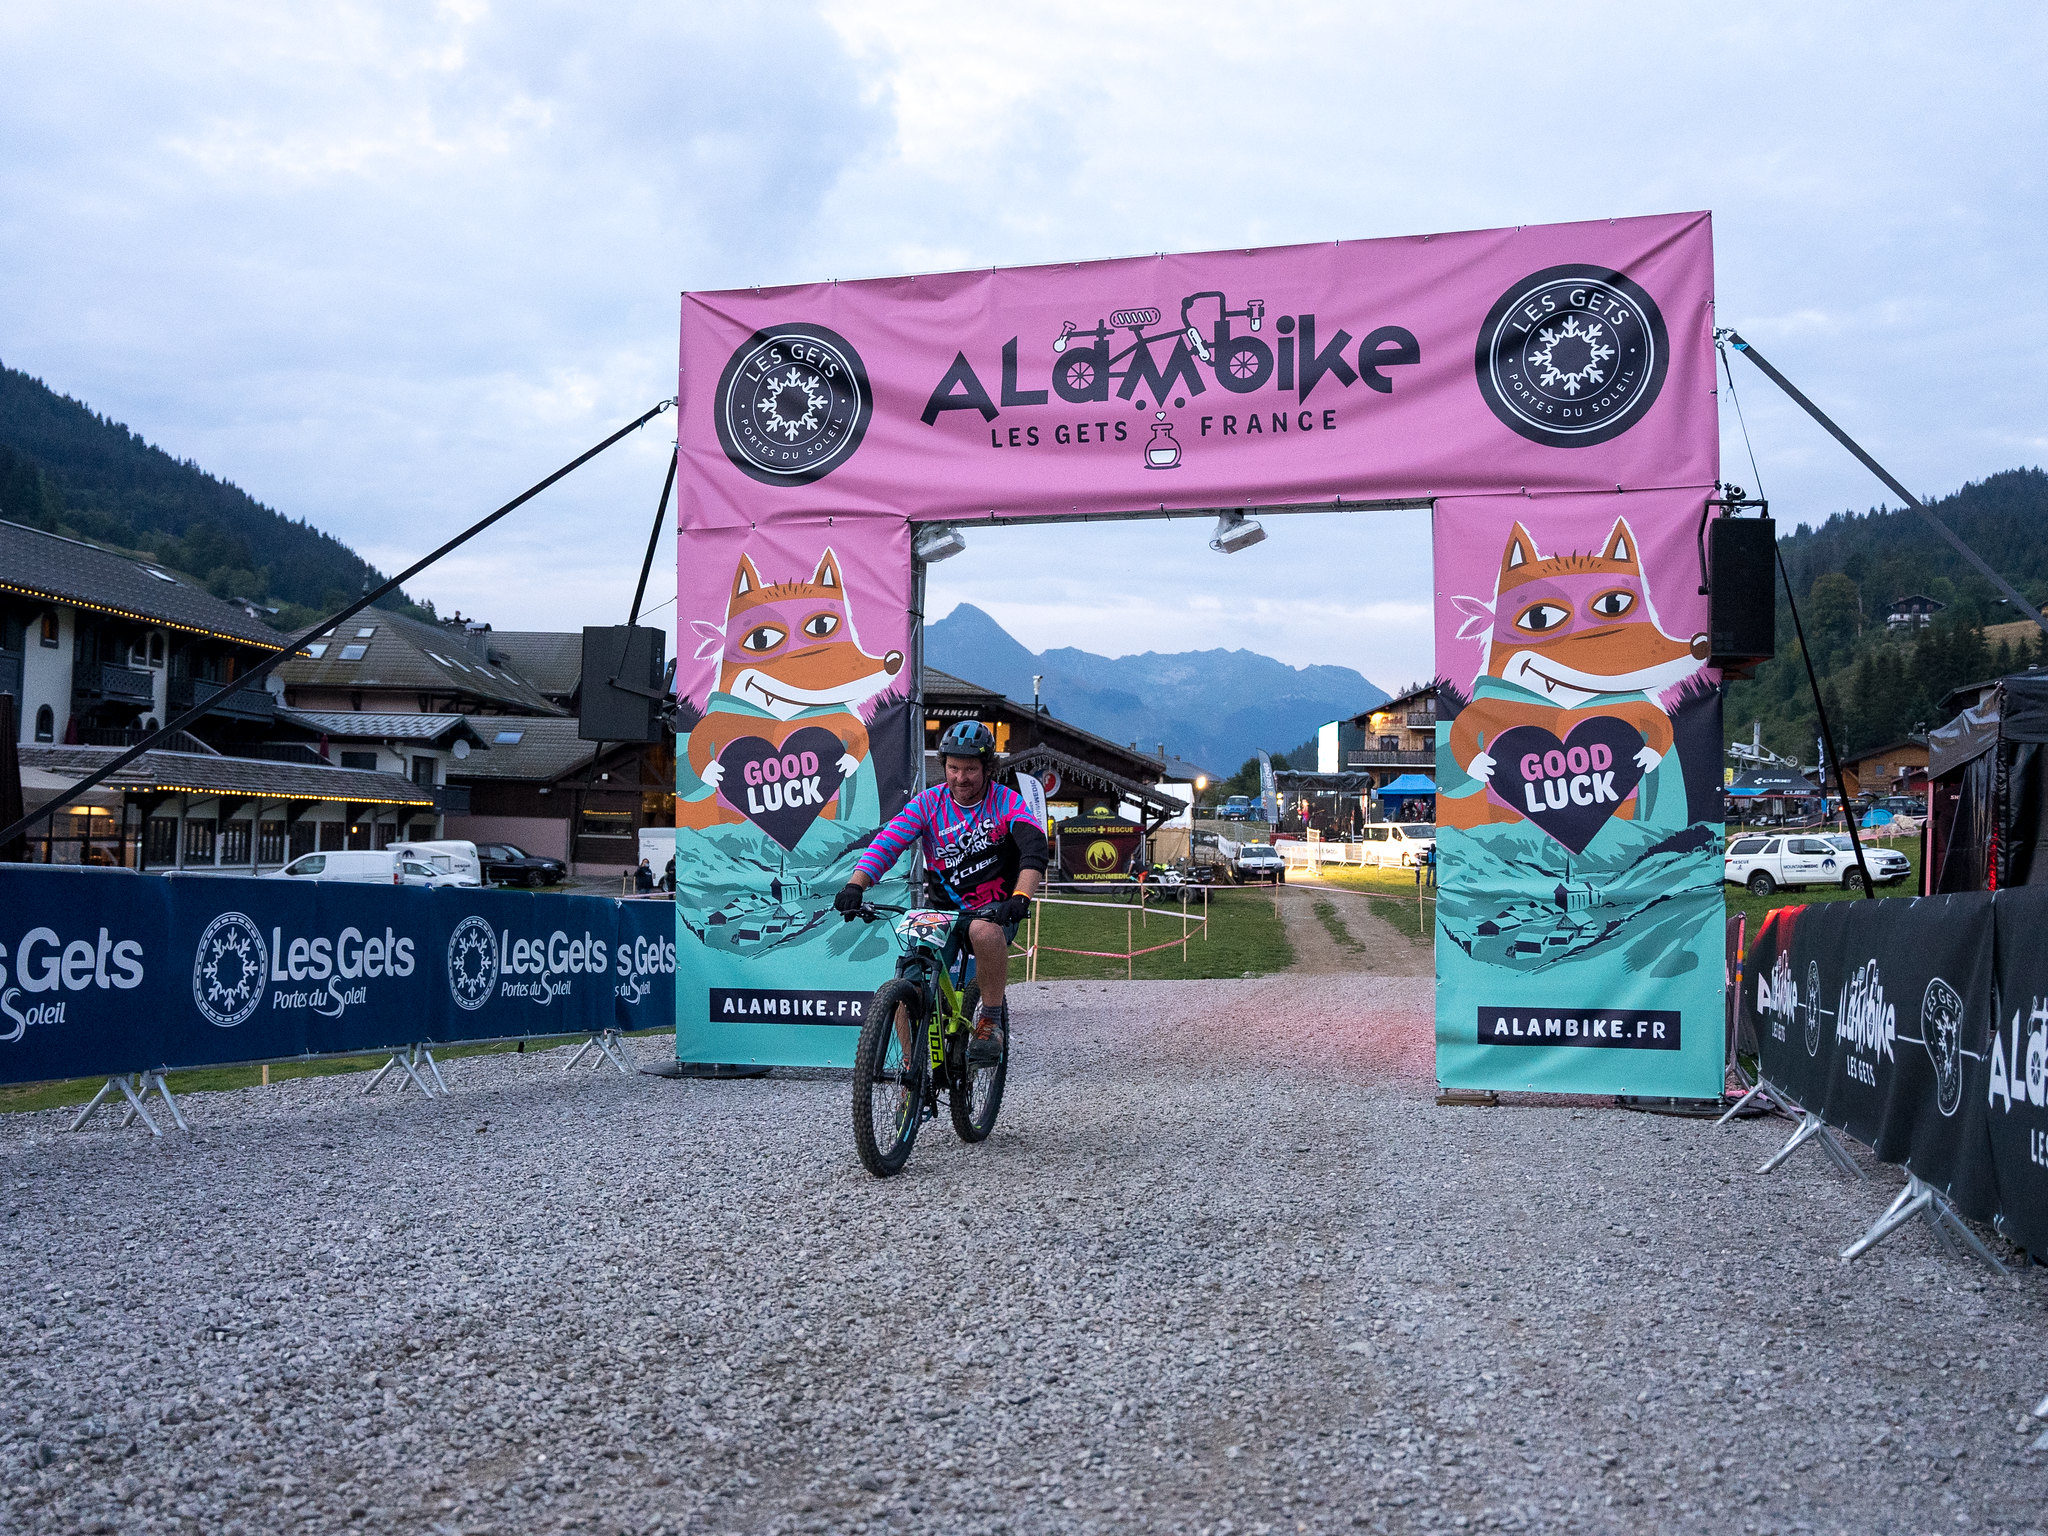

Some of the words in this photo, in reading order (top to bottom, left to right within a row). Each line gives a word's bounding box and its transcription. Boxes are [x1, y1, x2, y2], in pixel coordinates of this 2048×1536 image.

[1512, 295, 1556, 333] LES
[1569, 289, 1630, 325] GETS
[746, 348, 782, 382] LES
[791, 343, 839, 378] GETS
[1509, 373, 1554, 414] PORTES
[1563, 408, 1583, 417] DU
[1592, 370, 1634, 413] SOLEIL
[741, 419, 775, 457] PORTES
[782, 452, 799, 460] DU
[807, 418, 843, 456] SOLEIL
[991, 426, 1040, 448] LES
[1055, 420, 1128, 444] GETS
[1201, 410, 1337, 437] FRANCE
[932, 708, 979, 718] FRANÇAIS
[744, 751, 819, 786] GOOD
[1520, 743, 1613, 782] GOOD
[747, 776, 824, 815] LUCK
[1524, 771, 1620, 813] LUCK
[1064, 826, 1096, 834] SECOURS
[960, 855, 998, 878] CUBE
[921, 927, 928, 935] 9
[16, 926, 144, 992] Gets
[271, 926, 333, 982] Les
[337, 926, 416, 978] Gets
[500, 928, 546, 975] Les
[547, 930, 608, 975] Gets
[634, 934, 676, 976] Gets
[272, 990, 307, 1010] Portes
[308, 988, 327, 1007] du
[314, 974, 367, 1019] Soleil
[501, 980, 529, 997] Portes
[530, 982, 541, 997] du
[534, 969, 571, 1007] Soleil
[0, 987, 67, 1044] Soleil
[722, 997, 862, 1018] ALAMBIKE.FR
[1925, 990, 1937, 1023] LES
[1494, 1017, 1666, 1039] ALAMBIKE.FR
[1846, 1054, 1857, 1079] LES
[1858, 1060, 1876, 1088] GETS
[2031, 1128, 2048, 1168] LE
